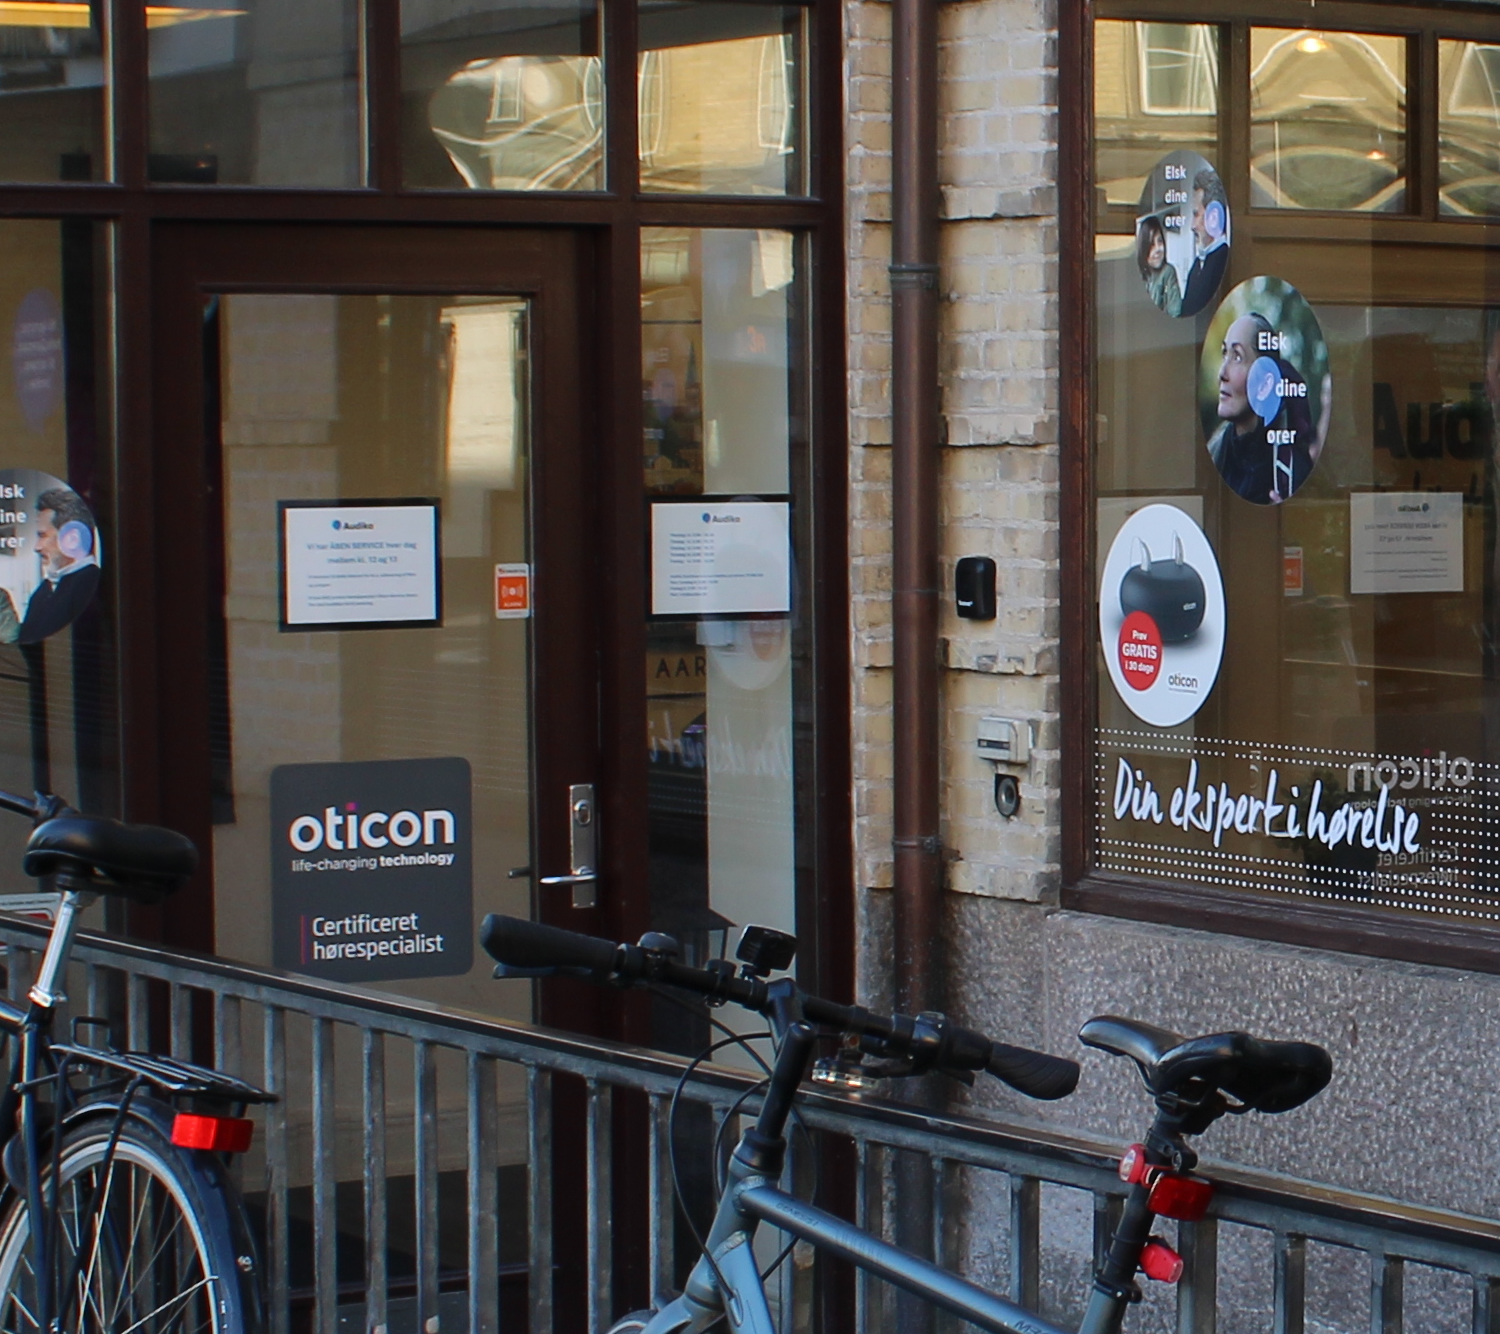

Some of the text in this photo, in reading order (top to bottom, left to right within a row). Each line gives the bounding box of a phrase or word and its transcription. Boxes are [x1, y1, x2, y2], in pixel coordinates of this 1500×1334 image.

[1165, 165, 1187, 180] Elsk
[1165, 188, 1188, 203] dine
[1165, 214, 1187, 228] ører
[1258, 331, 1287, 351] Elsk
[1275, 378, 1307, 397] dine
[1266, 428, 1298, 445] ører
[343, 522, 375, 530] Audika
[1122, 643, 1158, 660] GRATIS
[1129, 661, 1138, 671] 30
[1138, 662, 1155, 674] dage
[1168, 673, 1198, 688] oticon
[1113, 756, 1421, 854] Din ekspert i hørelse
[289, 801, 456, 853] oticon
[291, 852, 455, 872] life-changing technology
[312, 913, 418, 937] Certificeret
[312, 933, 444, 961] hørespecialist
